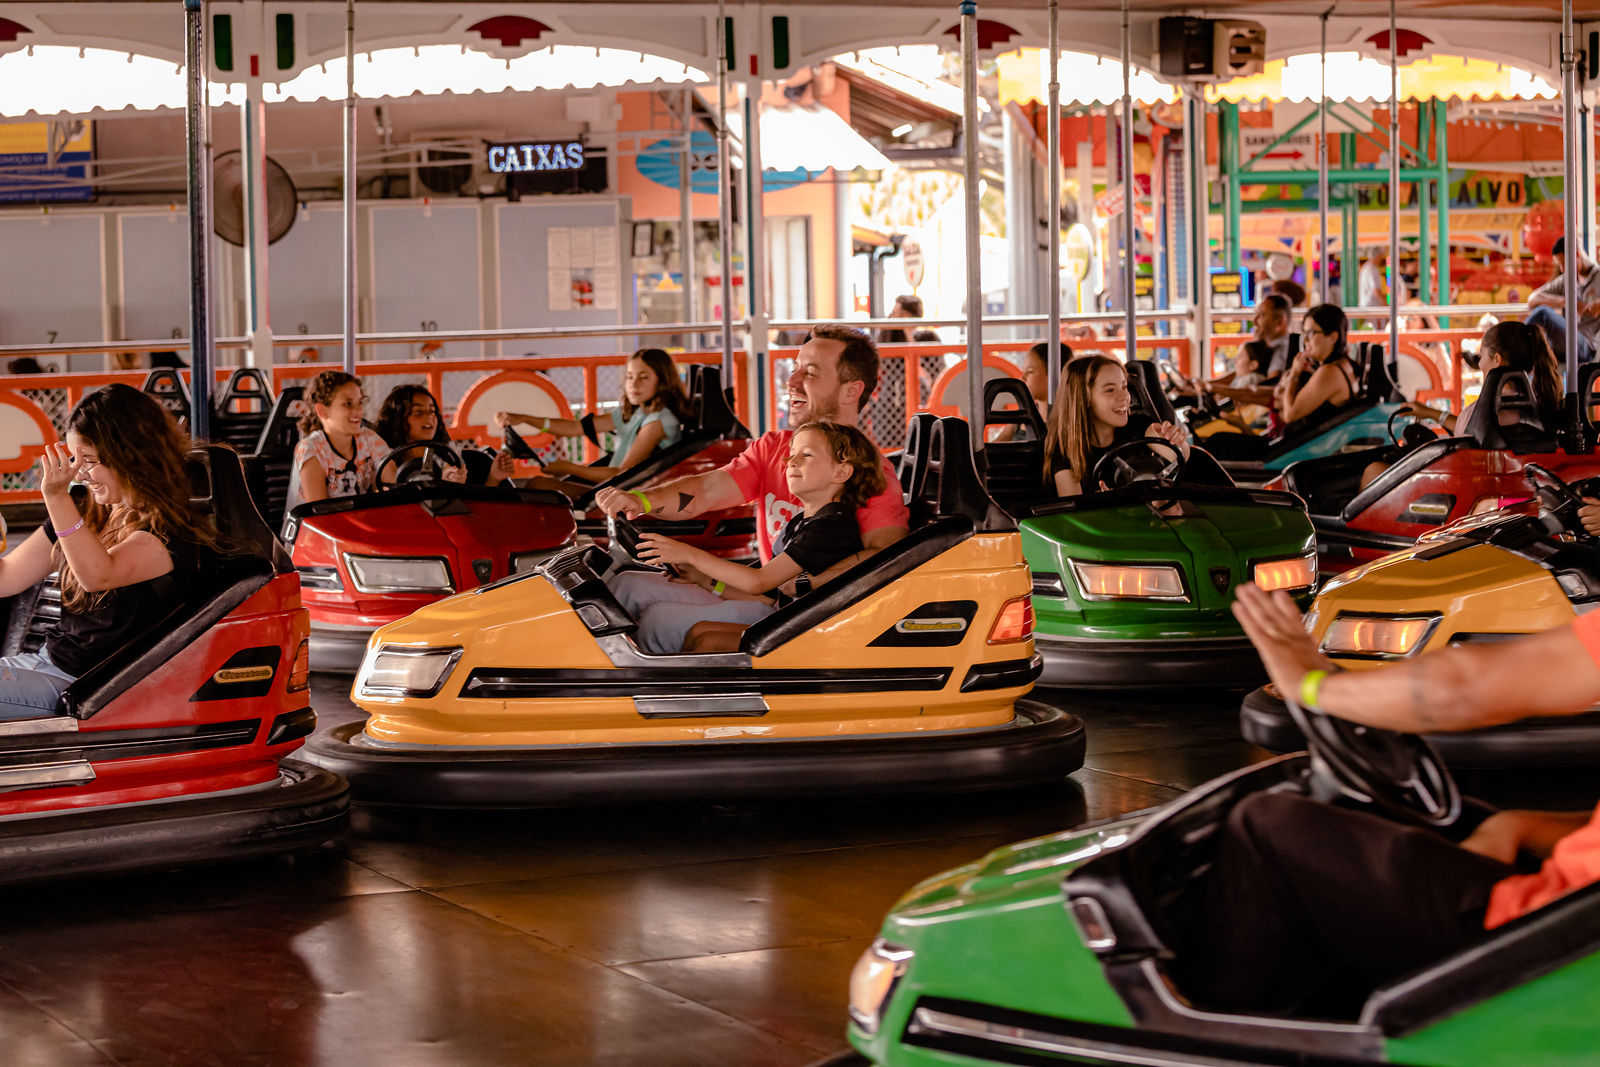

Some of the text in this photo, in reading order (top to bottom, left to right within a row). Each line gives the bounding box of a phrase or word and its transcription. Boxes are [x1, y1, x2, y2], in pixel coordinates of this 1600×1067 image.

[488, 143, 584, 172] CAIXAS
[1457, 181, 1520, 205] ALVO
[47, 331, 58, 344] 7
